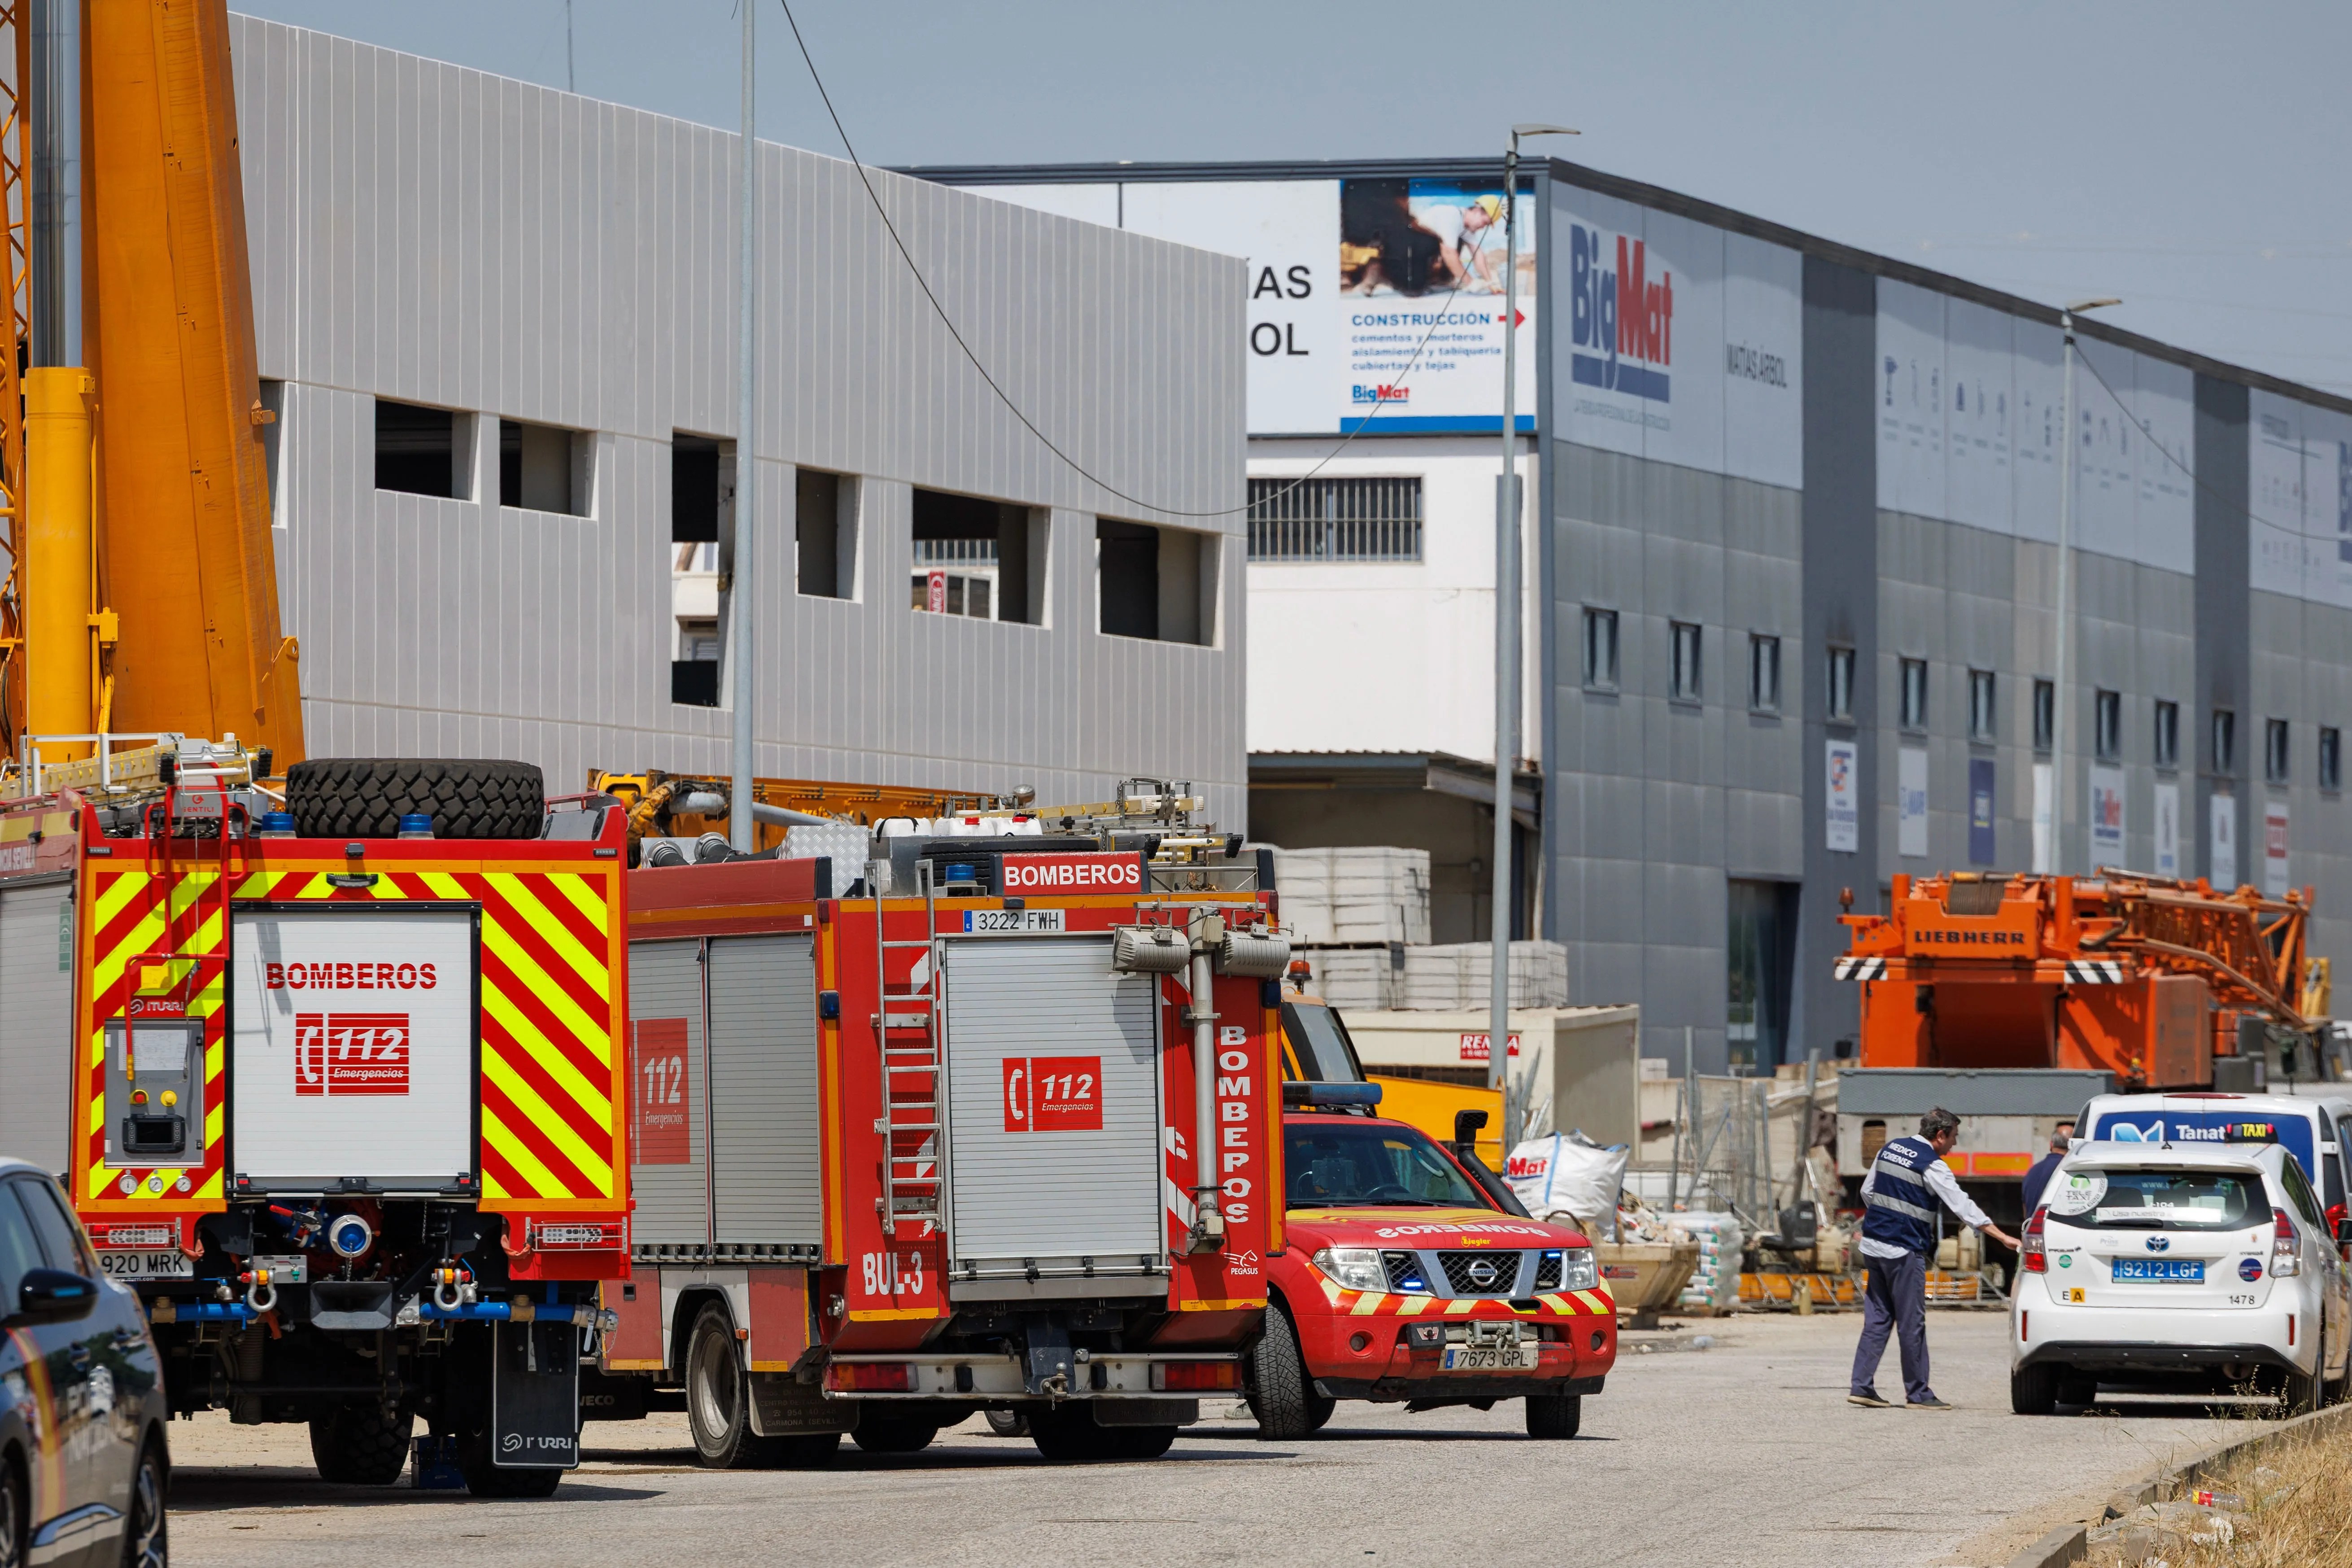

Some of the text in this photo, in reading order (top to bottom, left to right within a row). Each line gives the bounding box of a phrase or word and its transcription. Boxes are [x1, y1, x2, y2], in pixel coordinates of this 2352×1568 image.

[1570, 223, 1673, 391] BigMat
[1352, 311, 1491, 326] CONSTRUCCIÓN
[1352, 333, 1483, 344] cementos y morteros
[1352, 347, 1423, 357] aislamiento
[1427, 349, 1434, 357] y
[1352, 361, 1409, 370] cubiertas
[1426, 362, 1456, 371] tejas
[1353, 385, 1410, 402] BigMat
[1005, 864, 1140, 887] BOMBEROS
[978, 912, 1019, 930] 3222
[1028, 911, 1058, 930] FWH
[1914, 930, 2025, 945] LIEBHERR
[266, 963, 437, 989] BOMBEROS
[147, 1001, 184, 1011] ITURRI
[333, 1029, 403, 1061] 112
[1462, 1035, 1518, 1050] RENA
[333, 1067, 404, 1081] Emergencias
[644, 1055, 682, 1104] 112
[1041, 1074, 1093, 1100] 112
[1042, 1103, 1094, 1113] Emergencias
[645, 1110, 683, 1129] Emergencias
[2176, 1125, 2226, 1140] Tanat
[2241, 1123, 2266, 1137] TAXI
[1881, 1150, 1913, 1168] FORENSE
[1503, 1157, 1547, 1177] Mat
[102, 1254, 184, 1273] 920 MRK
[1230, 1267, 1258, 1275] PEGASUS
[2123, 1262, 2200, 1277] 9212 LGF
[863, 1251, 922, 1295] BUL-3
[2063, 1291, 2082, 1302] E A
[2228, 1295, 2255, 1305] 1478
[1458, 1351, 1496, 1367] 7673
[1502, 1350, 1528, 1367] GPL
[580, 1395, 615, 1406] VECO
